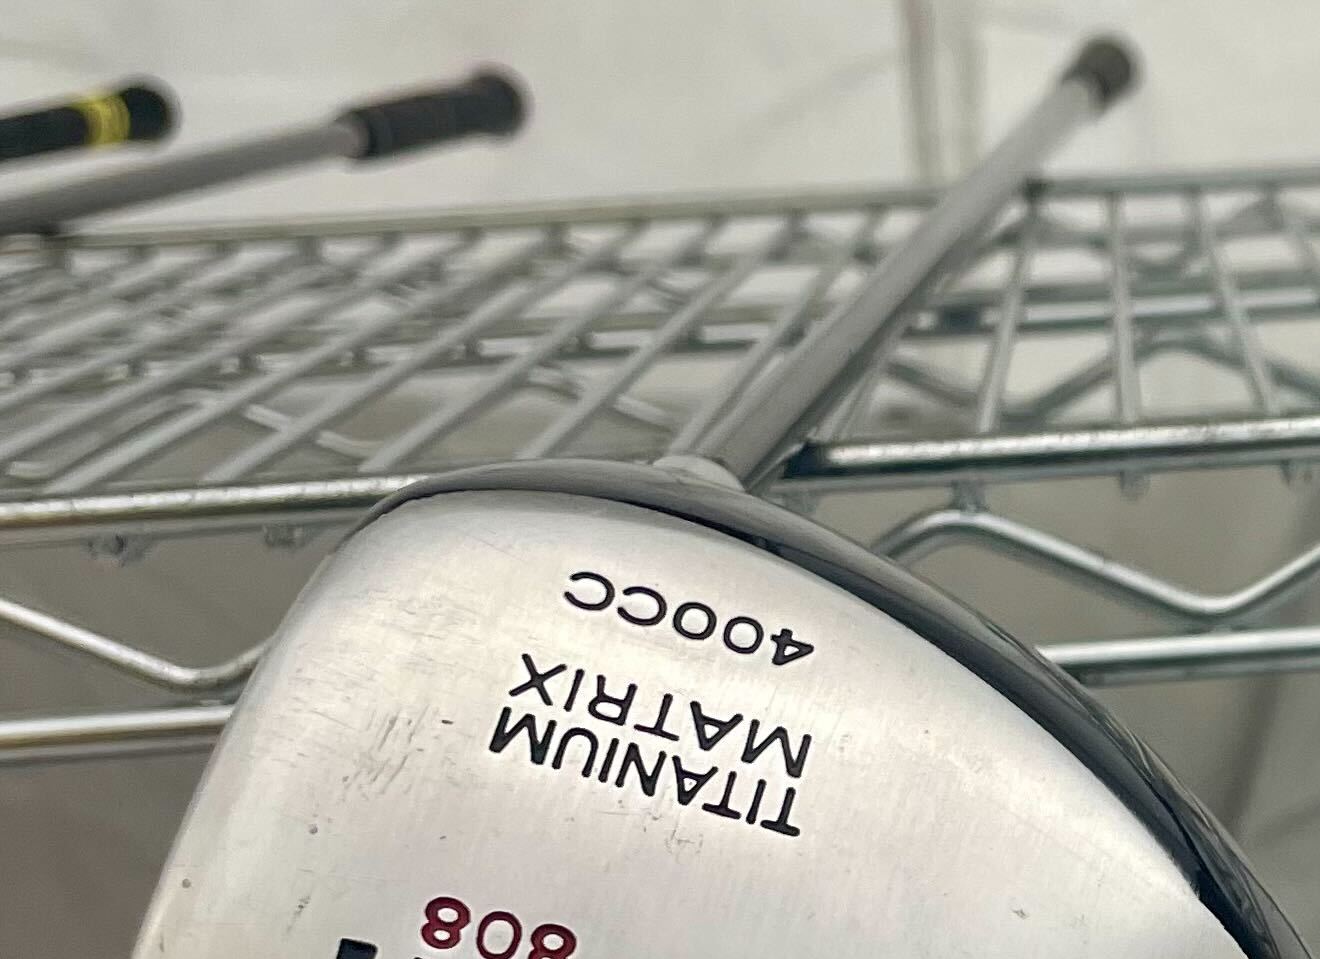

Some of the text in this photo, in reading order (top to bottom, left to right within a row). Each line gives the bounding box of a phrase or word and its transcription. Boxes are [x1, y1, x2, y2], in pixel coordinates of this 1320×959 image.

[563, 571, 815, 666] 400CC
[488, 706, 801, 837] TITANIUM
[508, 652, 813, 779] MATRIX
